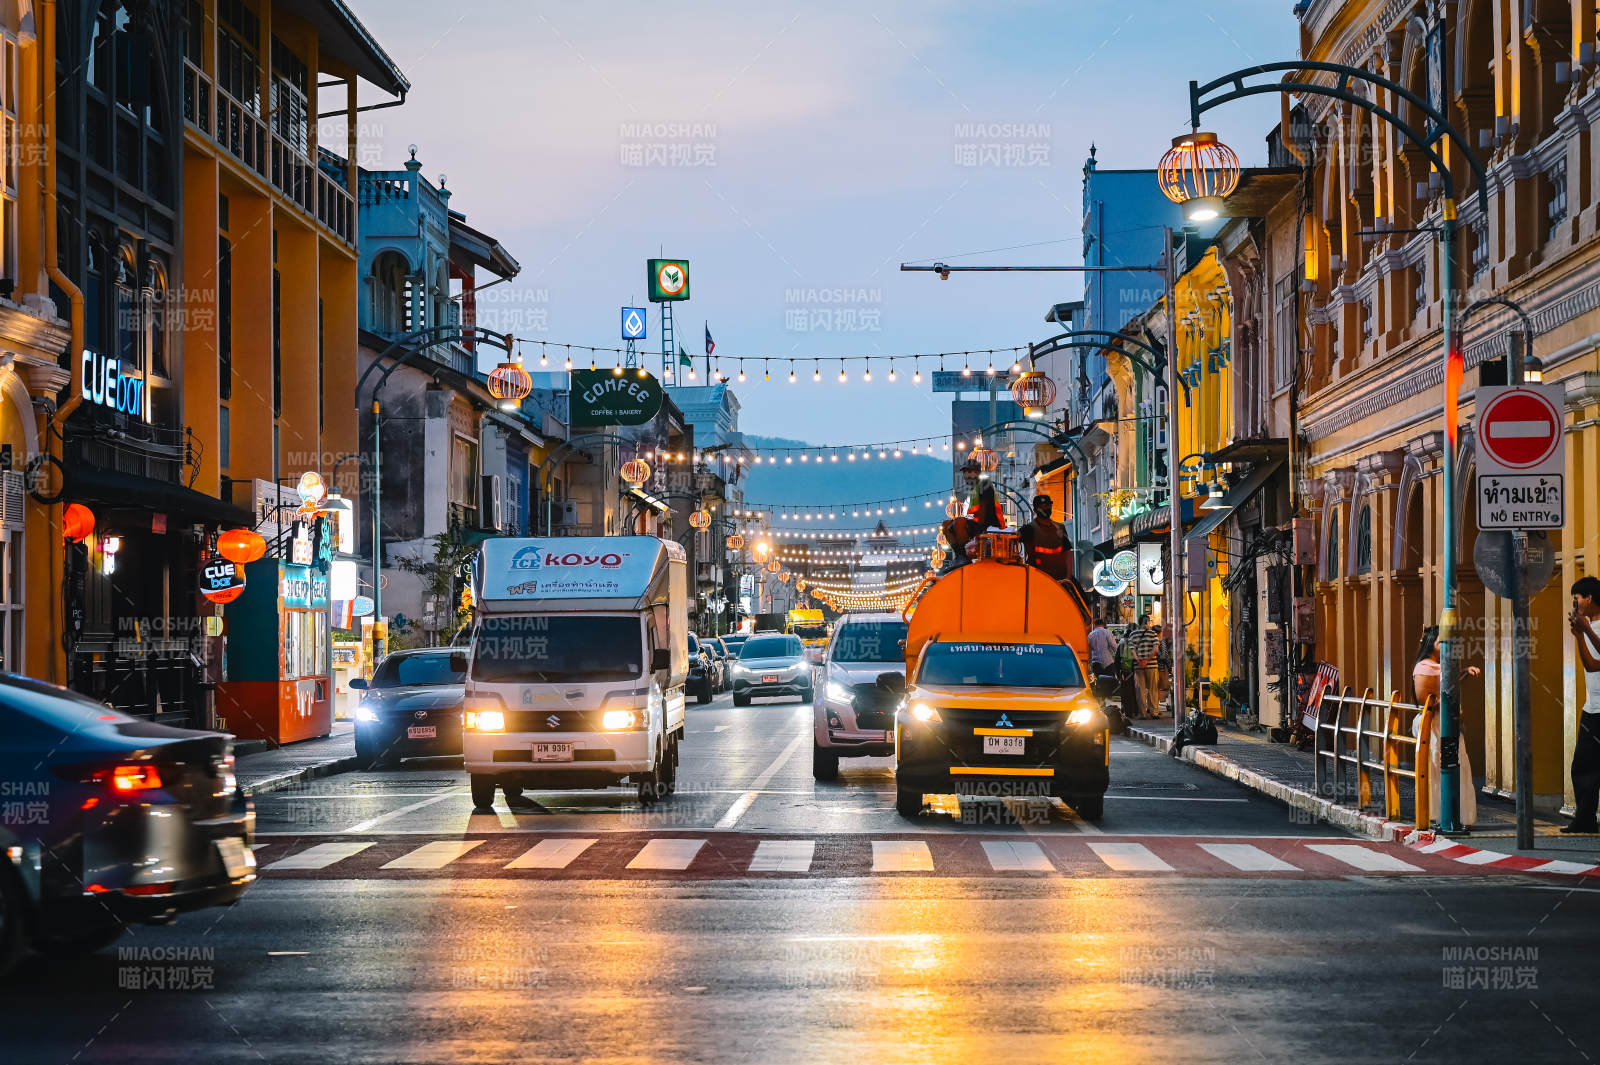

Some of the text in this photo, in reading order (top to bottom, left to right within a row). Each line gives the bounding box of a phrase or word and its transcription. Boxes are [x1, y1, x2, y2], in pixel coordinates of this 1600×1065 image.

[582, 378, 650, 404] COMFEE
[1491, 511, 1552, 522] NO ENTRY
[510, 558, 541, 569] ICE
[204, 563, 235, 579] CUE
[210, 577, 232, 588] bar
[950, 643, 1044, 656] เทศบาลนครภูเก็ต
[552, 744, 571, 752] 9391
